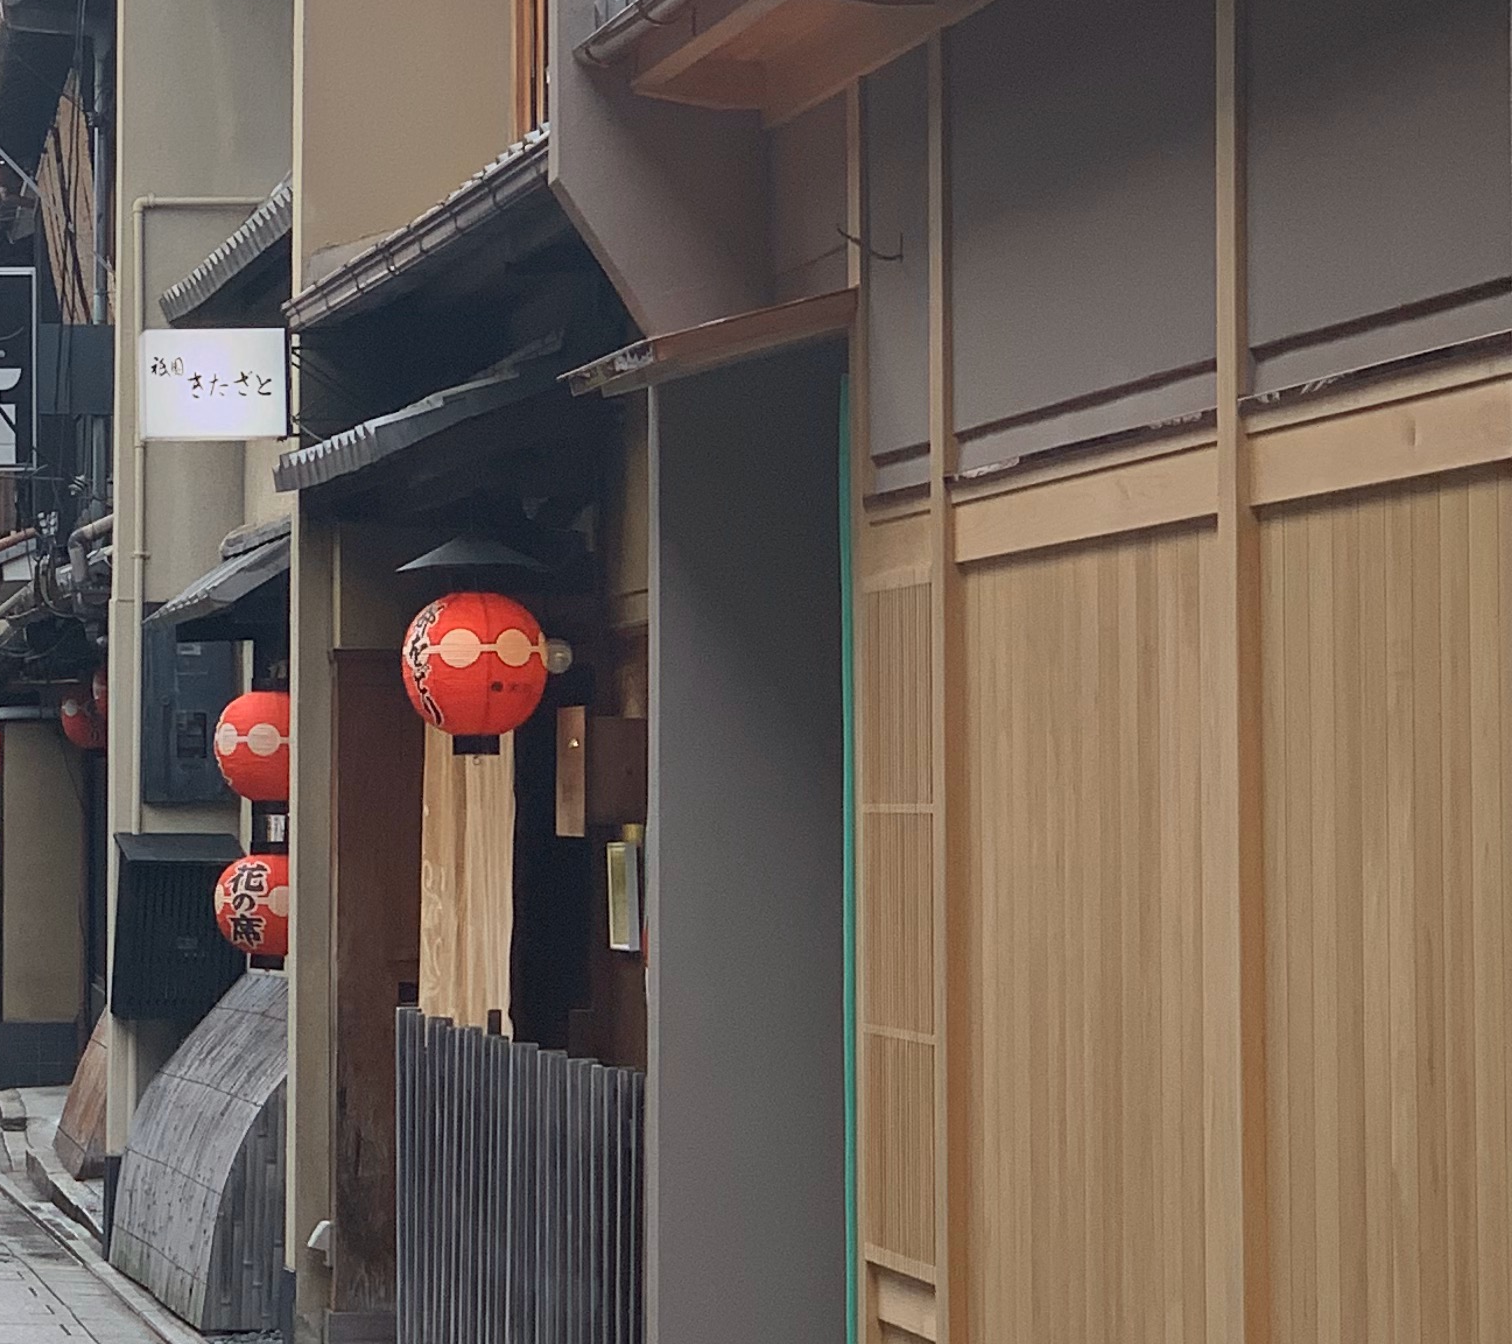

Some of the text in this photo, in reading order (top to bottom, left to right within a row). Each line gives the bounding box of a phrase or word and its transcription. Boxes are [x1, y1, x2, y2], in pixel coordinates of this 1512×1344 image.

[187, 370, 273, 399] きたざと
[229, 864, 269, 947] 花の席
